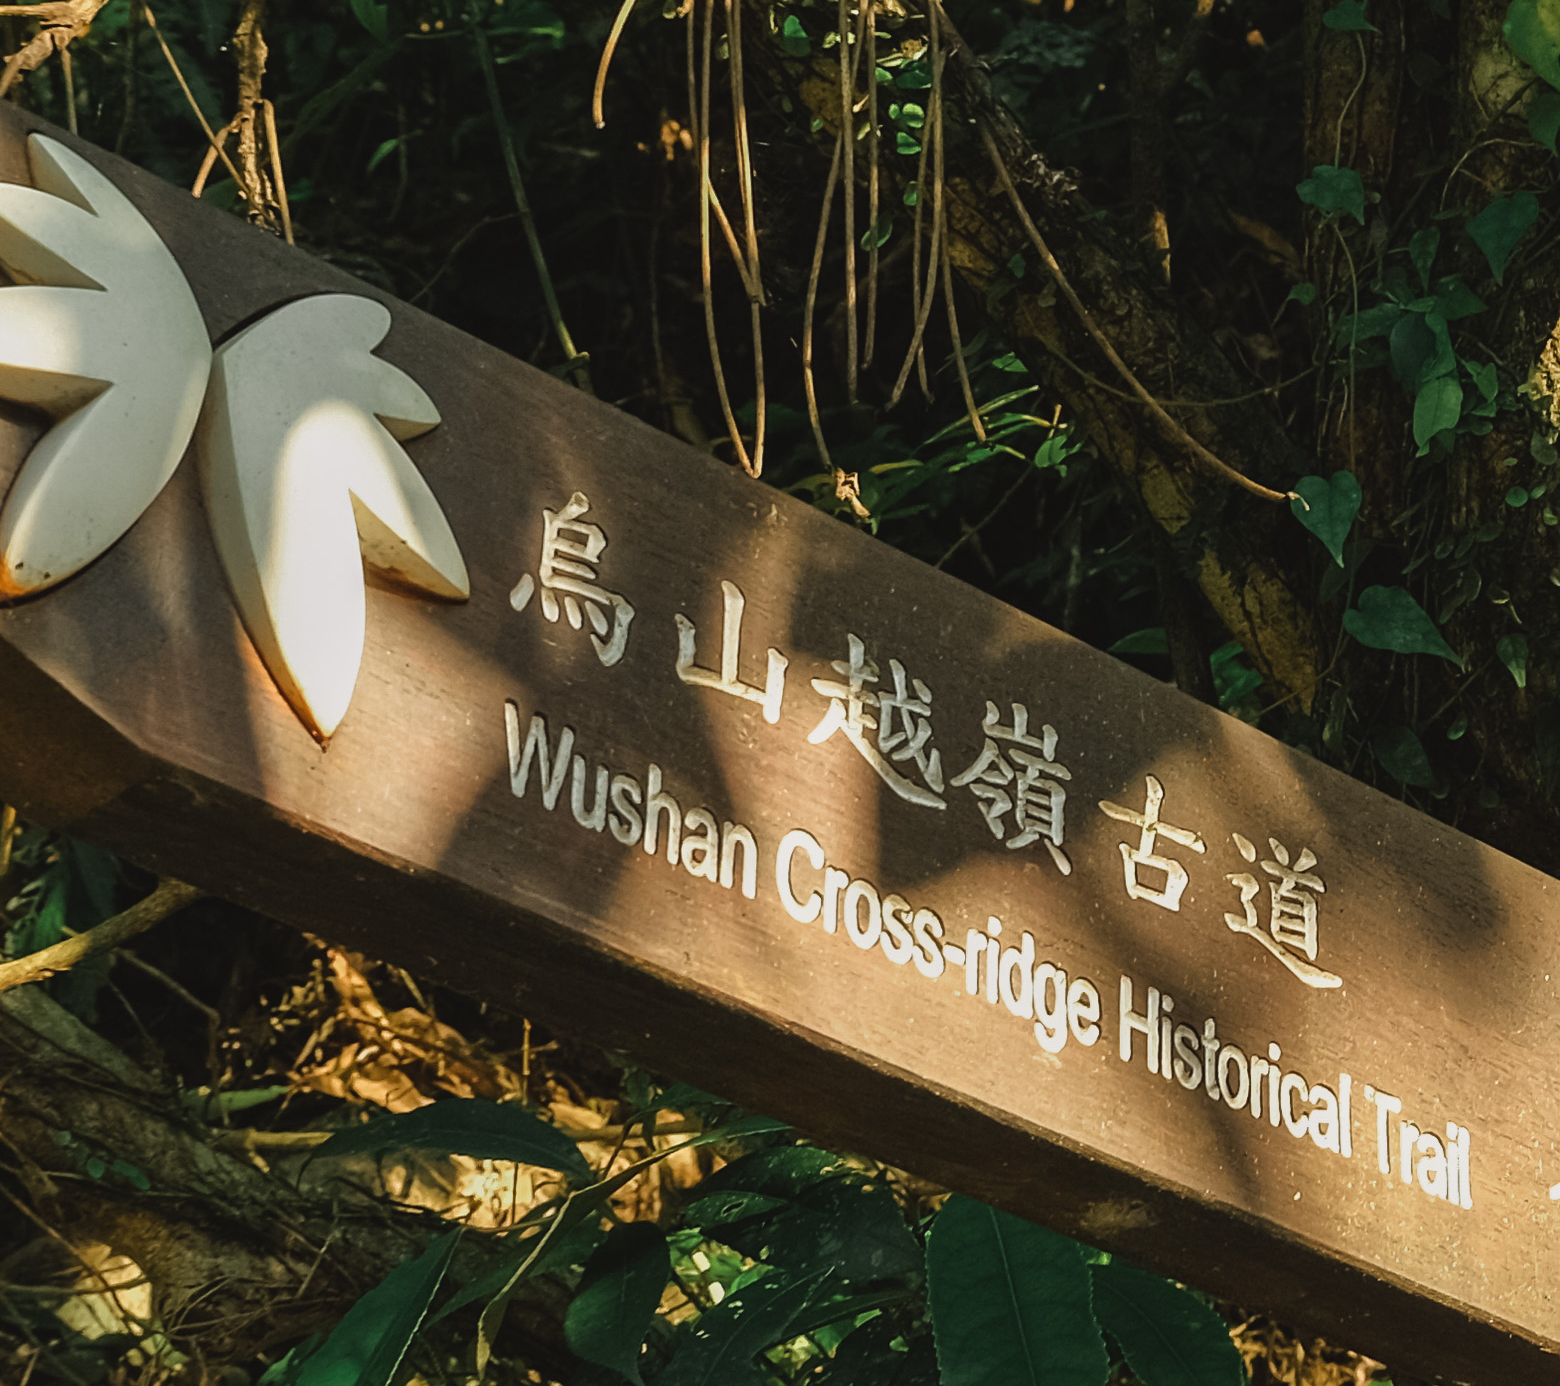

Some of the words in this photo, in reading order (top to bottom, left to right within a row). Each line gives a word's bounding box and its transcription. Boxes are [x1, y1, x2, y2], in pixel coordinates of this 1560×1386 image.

[502, 698, 761, 901] Wushan
[774, 827, 1104, 1055] Cross-ridge
[1118, 973, 1353, 1160] Historical
[1363, 1081, 1474, 1212] Trail
[508, 490, 1344, 989] 烏山越嶺古道
